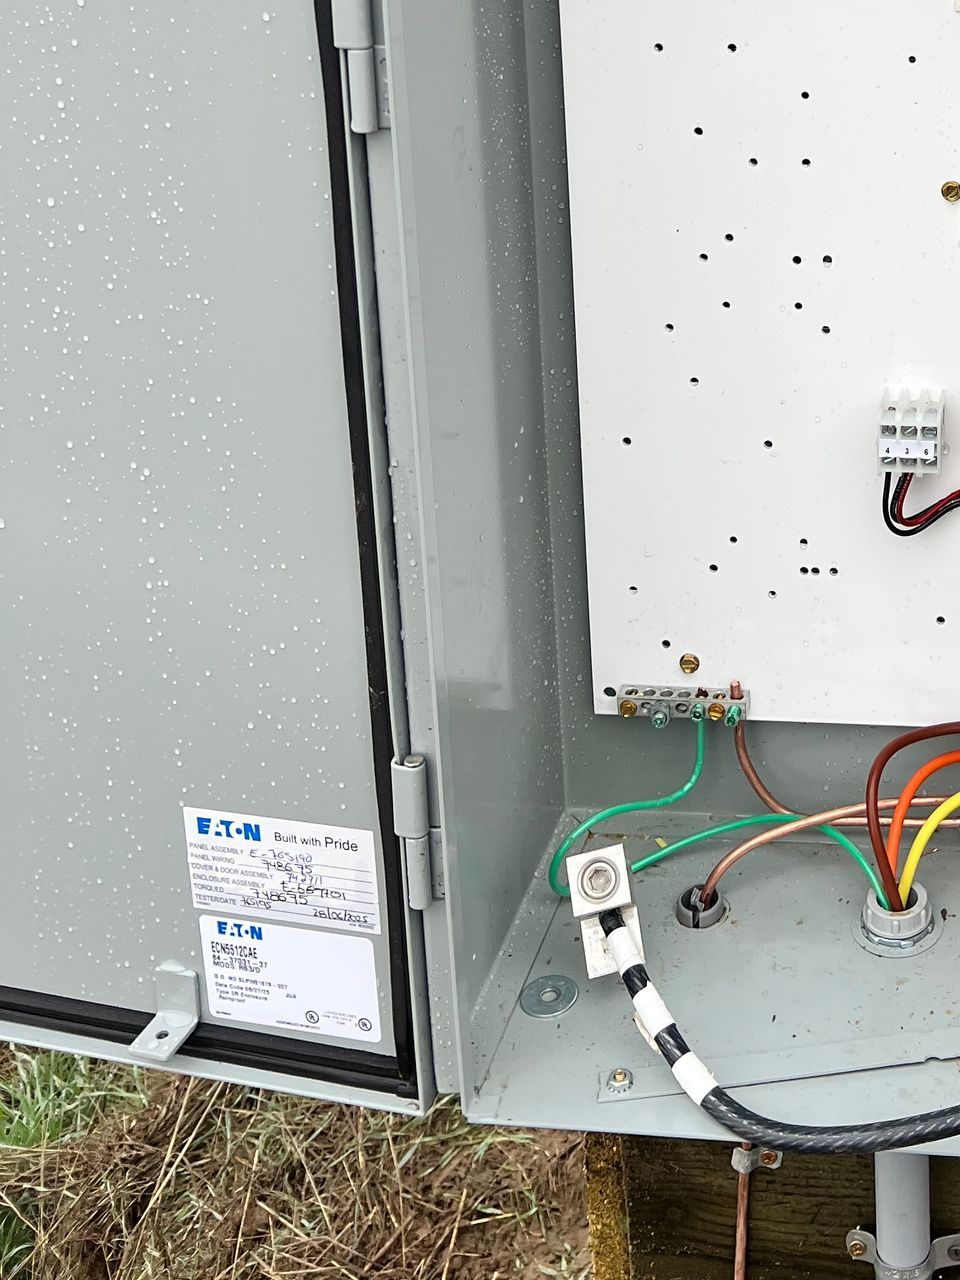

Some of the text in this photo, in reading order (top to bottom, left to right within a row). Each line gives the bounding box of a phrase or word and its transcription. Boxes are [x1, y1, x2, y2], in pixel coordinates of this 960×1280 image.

[196, 816, 262, 842] EATON
[189, 842, 244, 855] PANEL ASSEMBLY
[274, 831, 358, 852] Built with Pride
[190, 852, 235, 864] PANEL WIRING
[192, 863, 215, 872] COVER
[220, 866, 239, 874] DOOR
[240, 869, 274, 879] ASSEMBLY
[192, 873, 265, 889] ENCLOSURE ASSEMBLY
[194, 883, 224, 893] TORQUED
[217, 921, 263, 941] EATON
[211, 941, 258, 960] ECN5512CAE
[216, 988, 229, 996] Type
